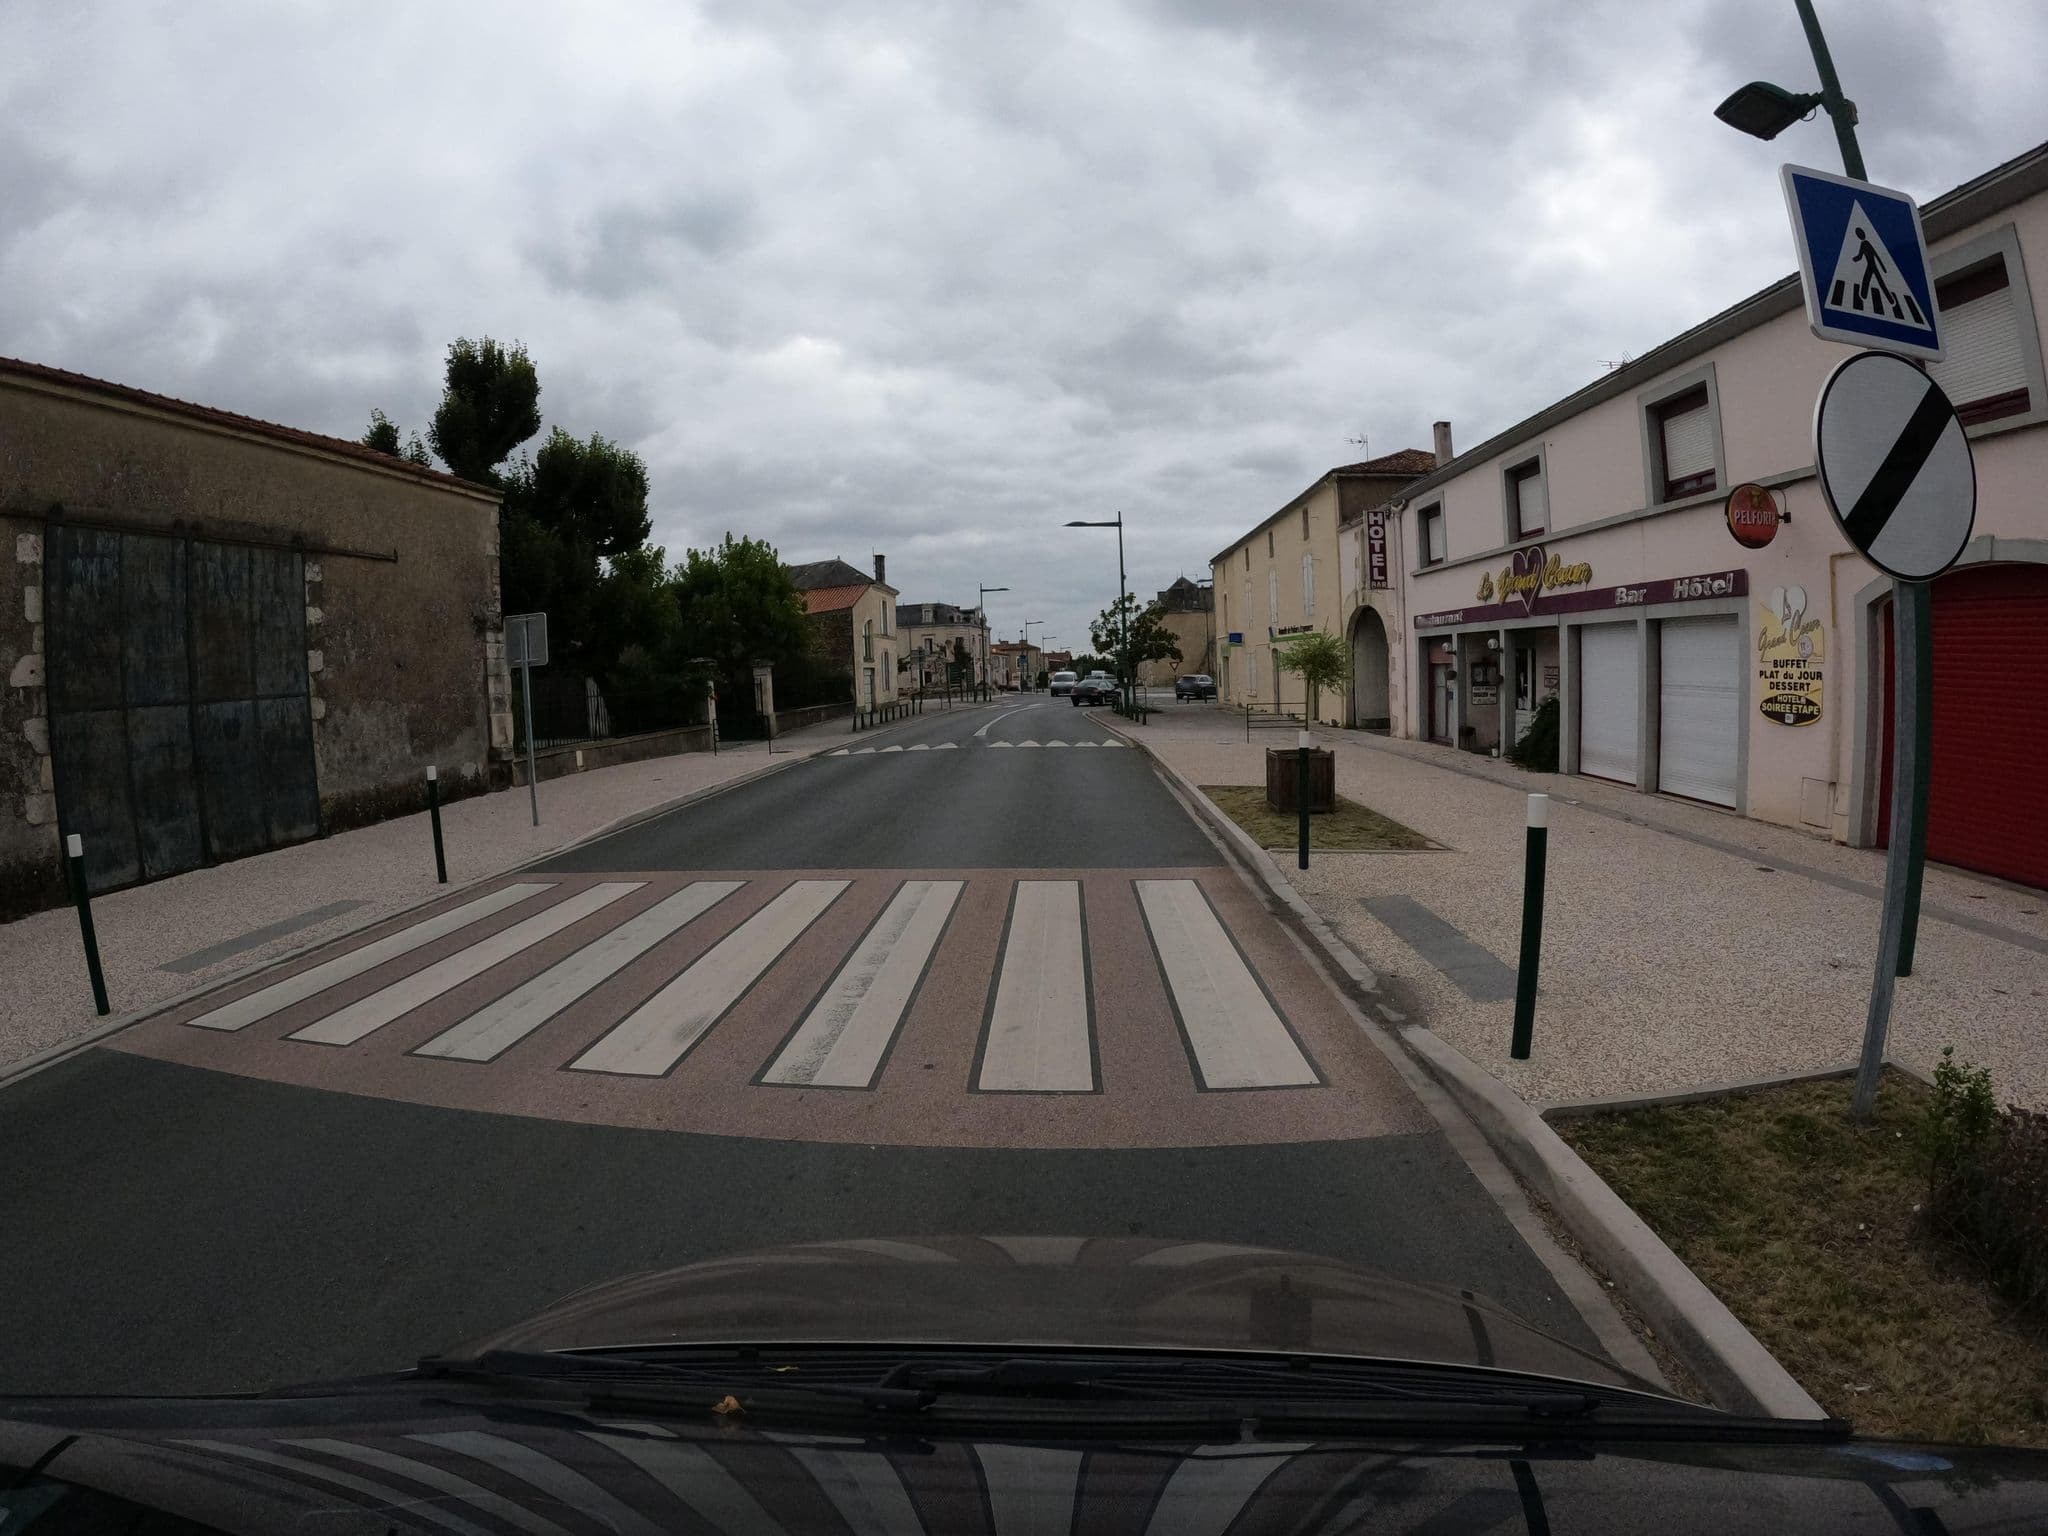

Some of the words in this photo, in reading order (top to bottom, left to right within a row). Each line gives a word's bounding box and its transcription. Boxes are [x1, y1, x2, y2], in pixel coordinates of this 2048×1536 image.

[1734, 509, 1777, 528] PELFORTH
[1368, 512, 1385, 580] HOTEL
[1673, 572, 1734, 600] Hôtel
[1615, 586, 1647, 605] Bar
[1416, 609, 1464, 626] Rtaurant
[1759, 670, 1780, 680] PLAT
[1782, 671, 1794, 680] du
[1797, 671, 1823, 681] JOUR
[1769, 681, 1811, 692] DESSERT
[1792, 704, 1821, 716] ETAPE
